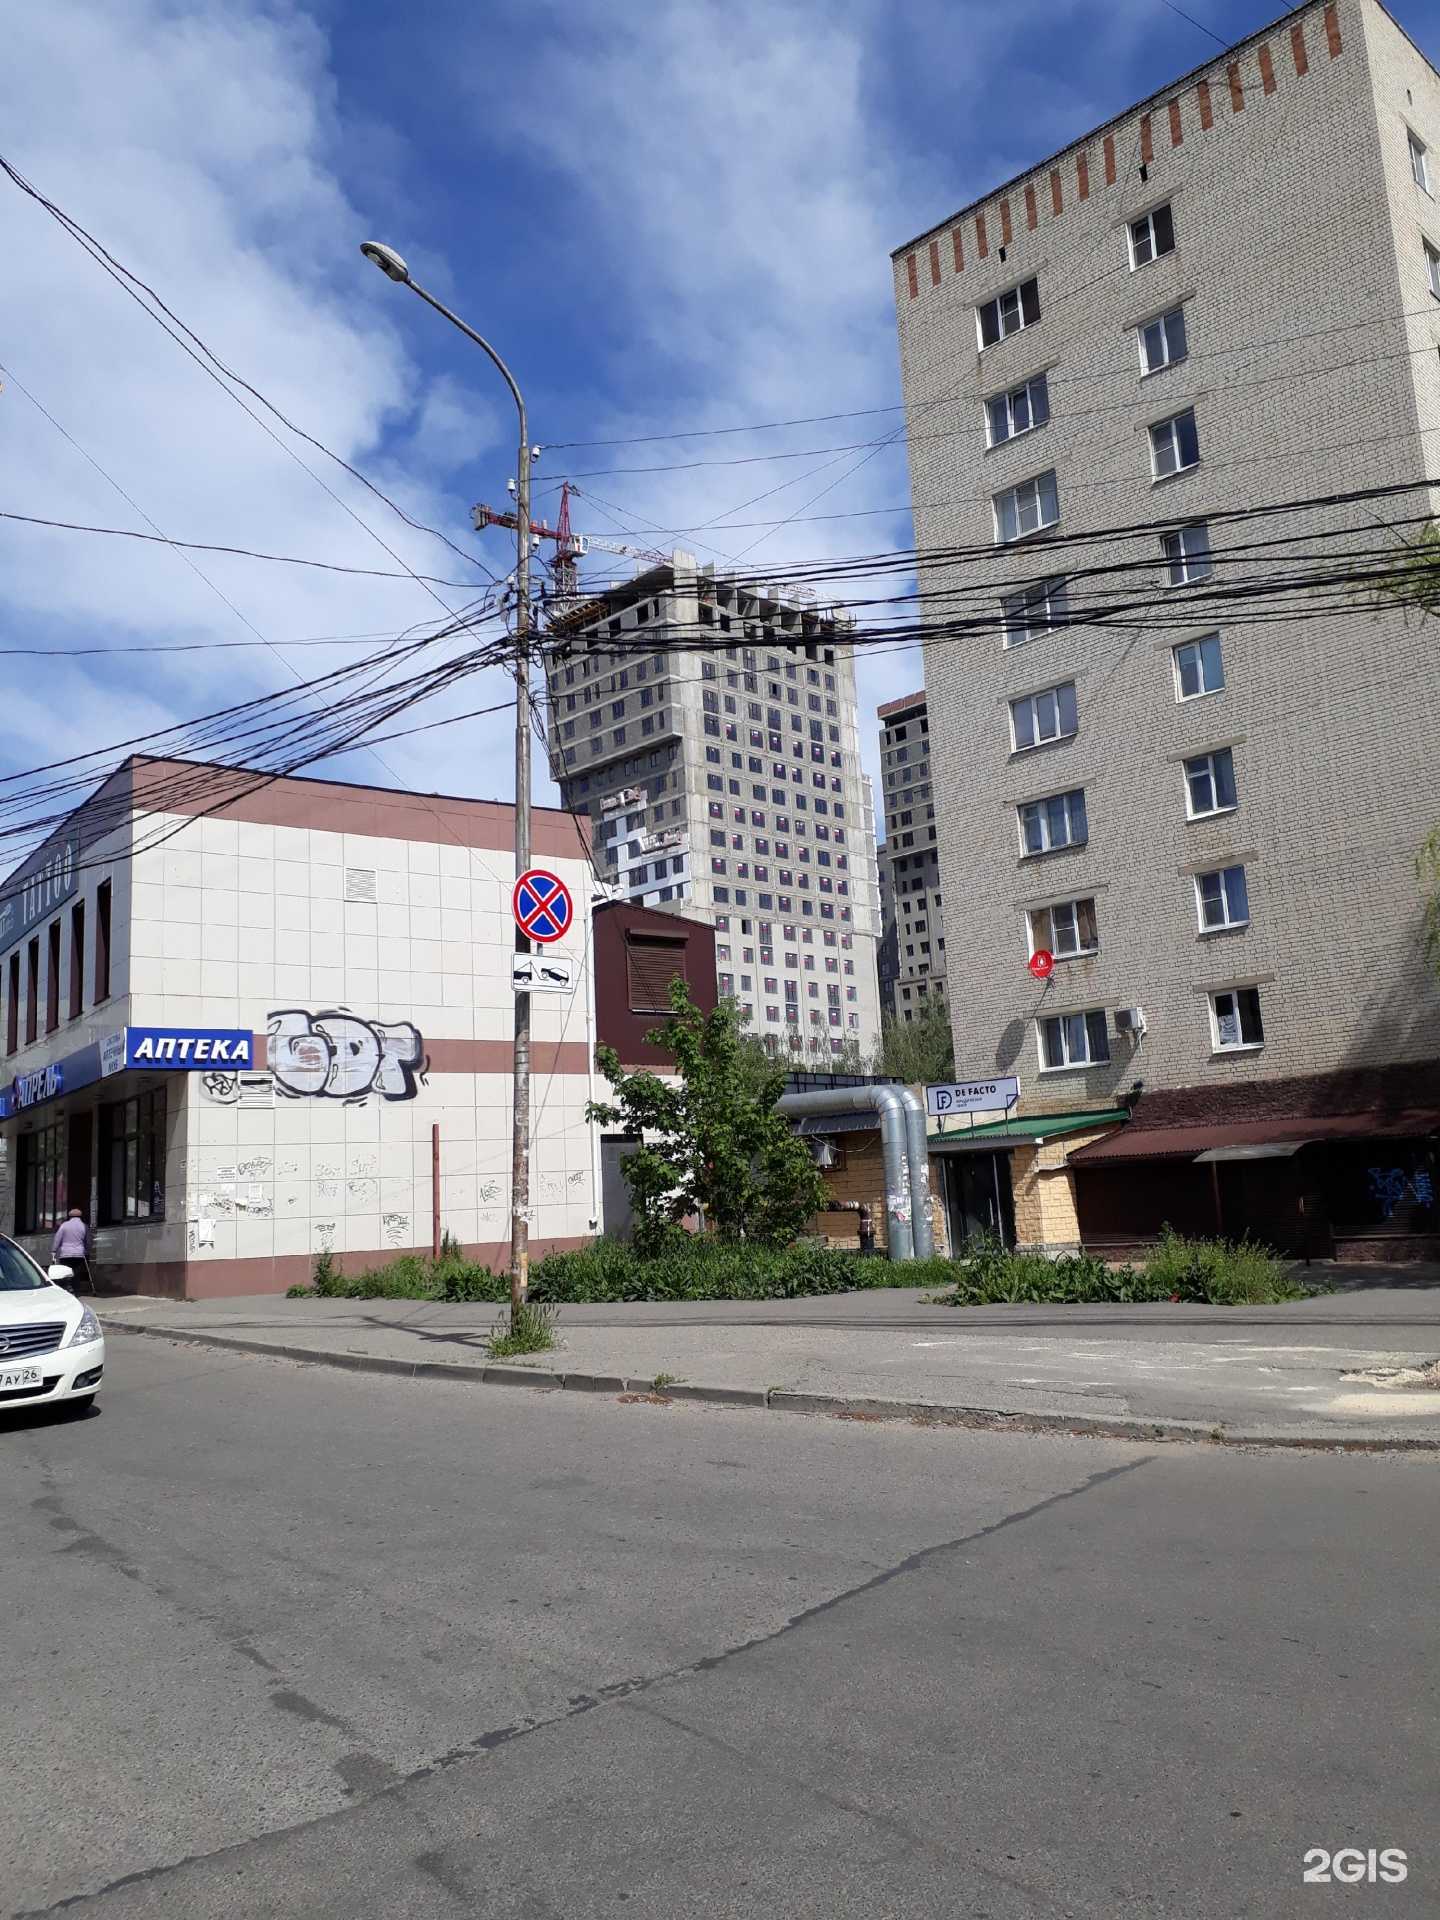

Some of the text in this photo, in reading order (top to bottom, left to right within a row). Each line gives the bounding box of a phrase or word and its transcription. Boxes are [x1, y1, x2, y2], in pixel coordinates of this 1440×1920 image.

[22, 843, 72, 925] TATTOO
[133, 1037, 249, 1060] АПТЕКА
[17, 1065, 57, 1110] АПРЕЛЬ
[955, 1085, 997, 1097] DE FACTO
